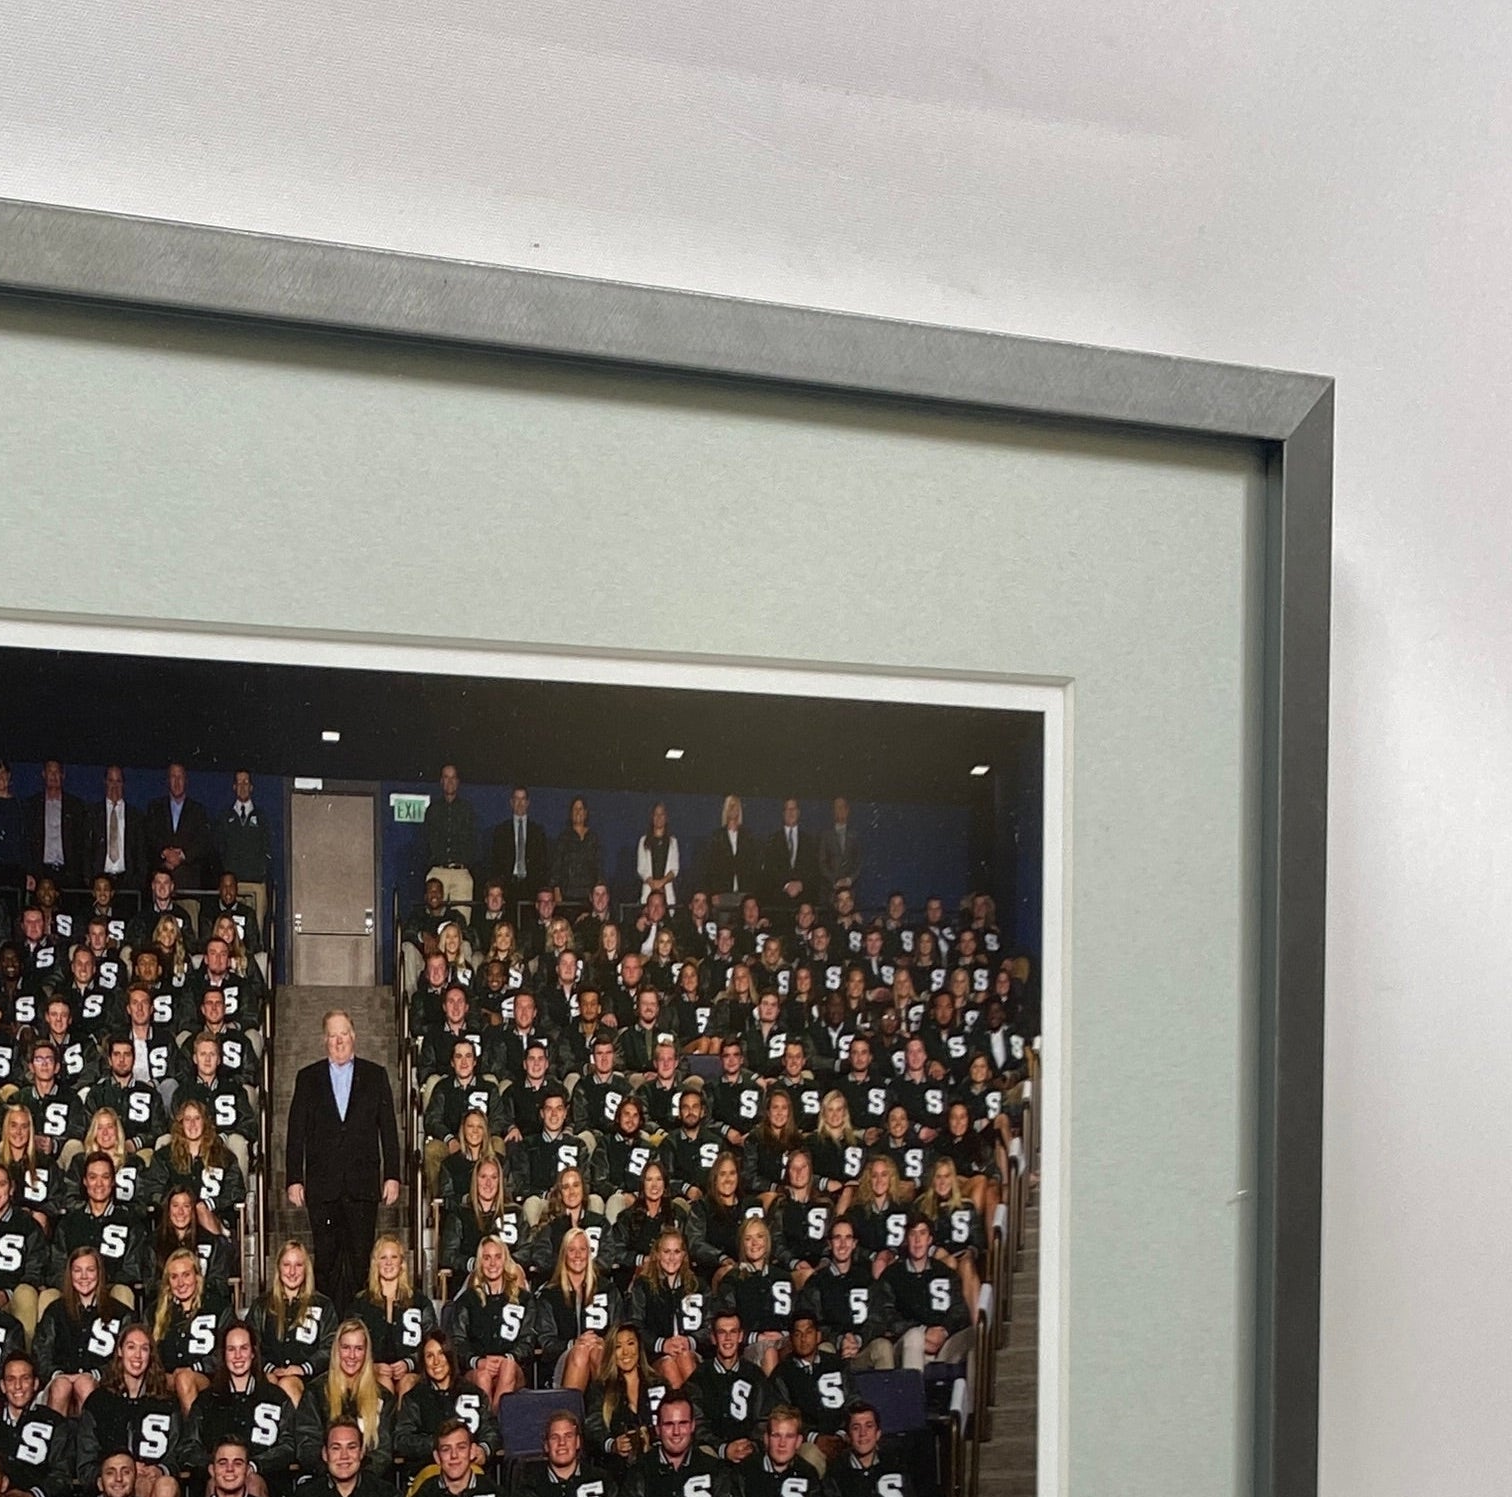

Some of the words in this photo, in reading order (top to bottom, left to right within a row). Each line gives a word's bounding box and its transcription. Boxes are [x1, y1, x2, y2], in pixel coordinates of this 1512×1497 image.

[57, 915, 72, 936] S
[108, 921, 124, 941] S
[705, 921, 717, 941] S
[850, 932, 861, 948] S
[901, 931, 912, 951] S
[986, 934, 998, 950] S
[37, 947, 54, 967] S
[99, 962, 118, 988] S
[778, 970, 790, 995] S
[826, 967, 841, 989] S
[881, 966, 894, 984] S
[932, 970, 945, 991] S
[974, 969, 987, 990] S
[16, 997, 35, 1021] S
[83, 995, 103, 1017] S
[154, 995, 172, 1022] S
[696, 1008, 710, 1033] S
[64, 1044, 83, 1074] S
[223, 1041, 241, 1068] S
[769, 1033, 786, 1058] S
[838, 1034, 854, 1060] S
[948, 1037, 966, 1057] S
[1010, 1035, 1023, 1059] S
[149, 1047, 167, 1078] S
[129, 1092, 151, 1122] S
[215, 1095, 236, 1125] S
[604, 1092, 622, 1120] S
[740, 1090, 758, 1118] S
[801, 1091, 820, 1113] S
[869, 1089, 885, 1115] S
[925, 1090, 943, 1114] S
[986, 1092, 1001, 1119] S
[44, 1103, 68, 1135] S
[557, 1145, 578, 1172] S
[629, 1148, 649, 1175] S
[699, 1143, 719, 1167] S
[845, 1147, 862, 1176] S
[905, 1149, 923, 1178] S
[115, 1166, 136, 1200] S
[200, 1167, 223, 1198] S
[808, 1208, 827, 1239] S
[887, 1214, 906, 1246] S
[952, 1211, 970, 1242] S
[100, 1225, 128, 1258] S
[772, 1282, 791, 1315] S
[850, 1289, 868, 1323] S
[930, 1279, 950, 1310] S
[500, 1304, 525, 1341] S
[586, 1294, 608, 1330] S
[682, 1294, 703, 1331] S
[189, 1315, 216, 1354] S
[403, 1308, 421, 1346] S
[731, 1380, 751, 1420] S
[818, 1372, 844, 1408] S
[251, 1403, 281, 1446] S
[454, 1395, 478, 1433] S
[17, 1422, 53, 1464] S
[140, 1414, 170, 1458] S
